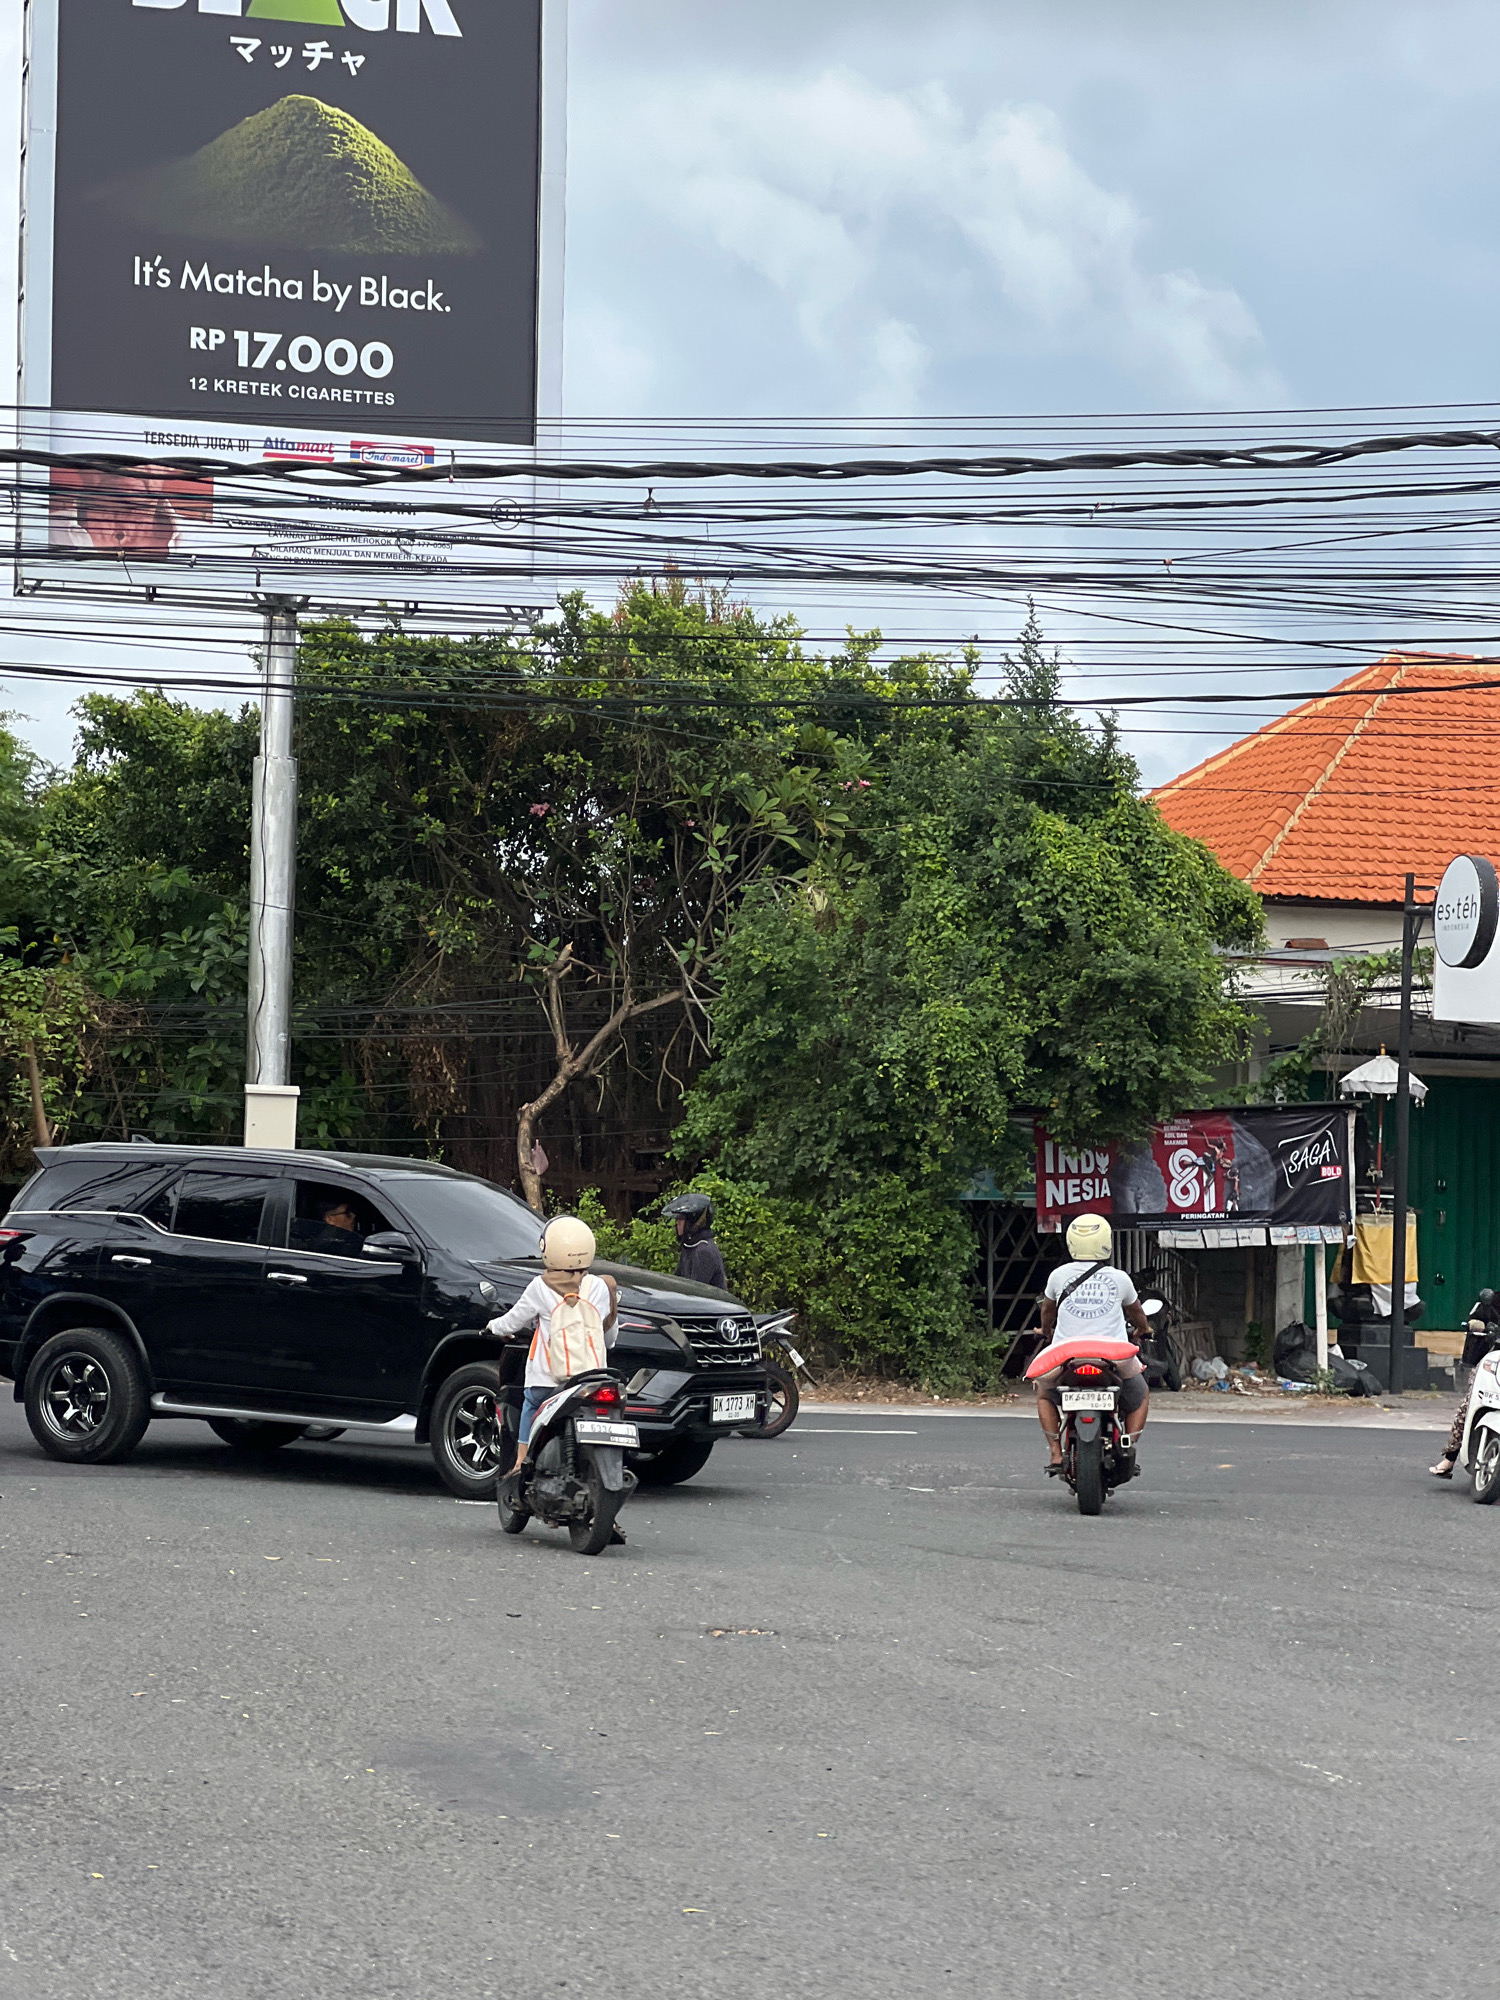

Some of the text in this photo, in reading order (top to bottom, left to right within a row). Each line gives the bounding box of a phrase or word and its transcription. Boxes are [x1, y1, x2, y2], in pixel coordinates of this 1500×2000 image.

[229, 35, 366, 76] マッチャ
[134, 255, 451, 312] It's Matcha by Black.
[190, 327, 394, 379] RP 17.000
[189, 377, 396, 406] 12 KRETEK CIGARETTES
[144, 431, 200, 448] TERSEDIA
[203, 436, 233, 451] JUGA
[239, 439, 249, 452] DI
[365, 450, 421, 464] Indomaret
[270, 546, 312, 555] DILARANG
[313, 548, 352, 558] MENJUAL
[354, 550, 372, 559] DAN
[1288, 1139, 1331, 1174] SAGA
[1321, 1166, 1342, 1177] BOLD
[1045, 1178, 1111, 1208] NESIA
[714, 1398, 723, 1412] DK
[726, 1397, 743, 1411] 1773
[1064, 1393, 1074, 1401] DK
